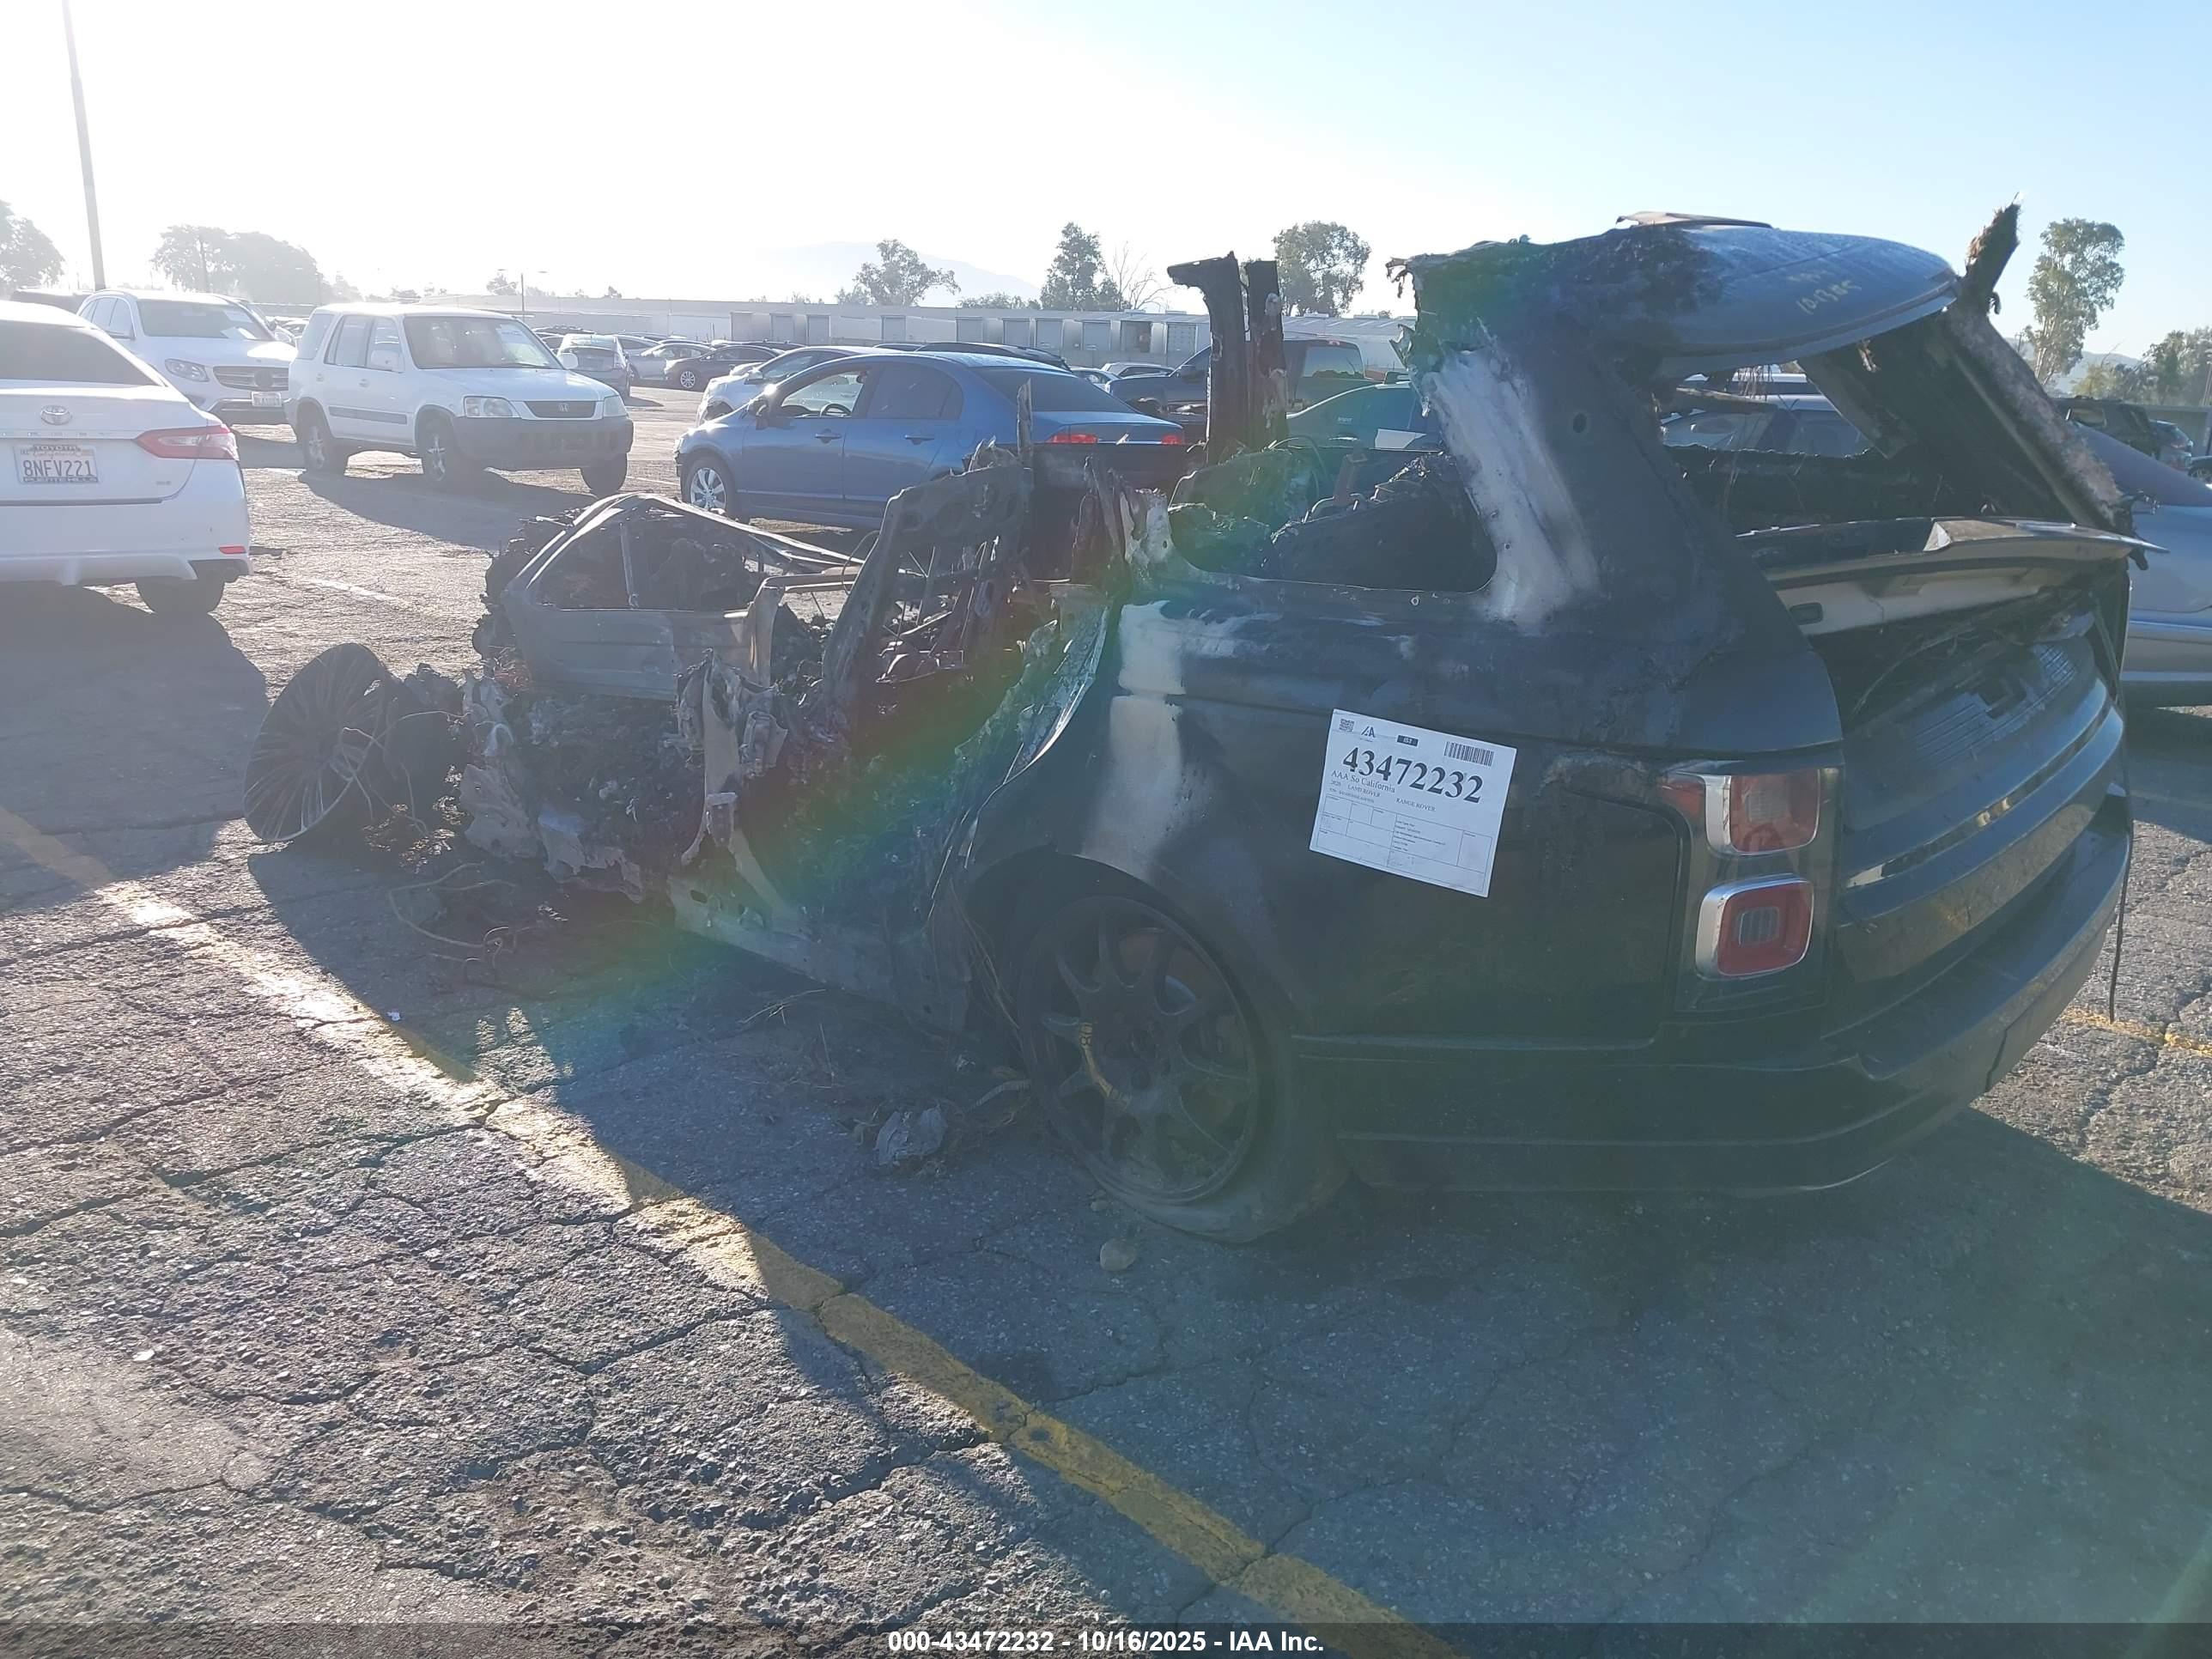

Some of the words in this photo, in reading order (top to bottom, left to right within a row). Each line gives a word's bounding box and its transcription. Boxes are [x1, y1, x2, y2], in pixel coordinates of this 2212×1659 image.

[22, 459, 94, 477] 8NFV221
[1331, 769, 1349, 781] AAA
[1351, 773, 1360, 783] So
[1361, 778, 1395, 793] California
[1342, 747, 1483, 804] 43472232
[1395, 798, 1416, 807] RANGE
[1416, 801, 1437, 812] ROVER
